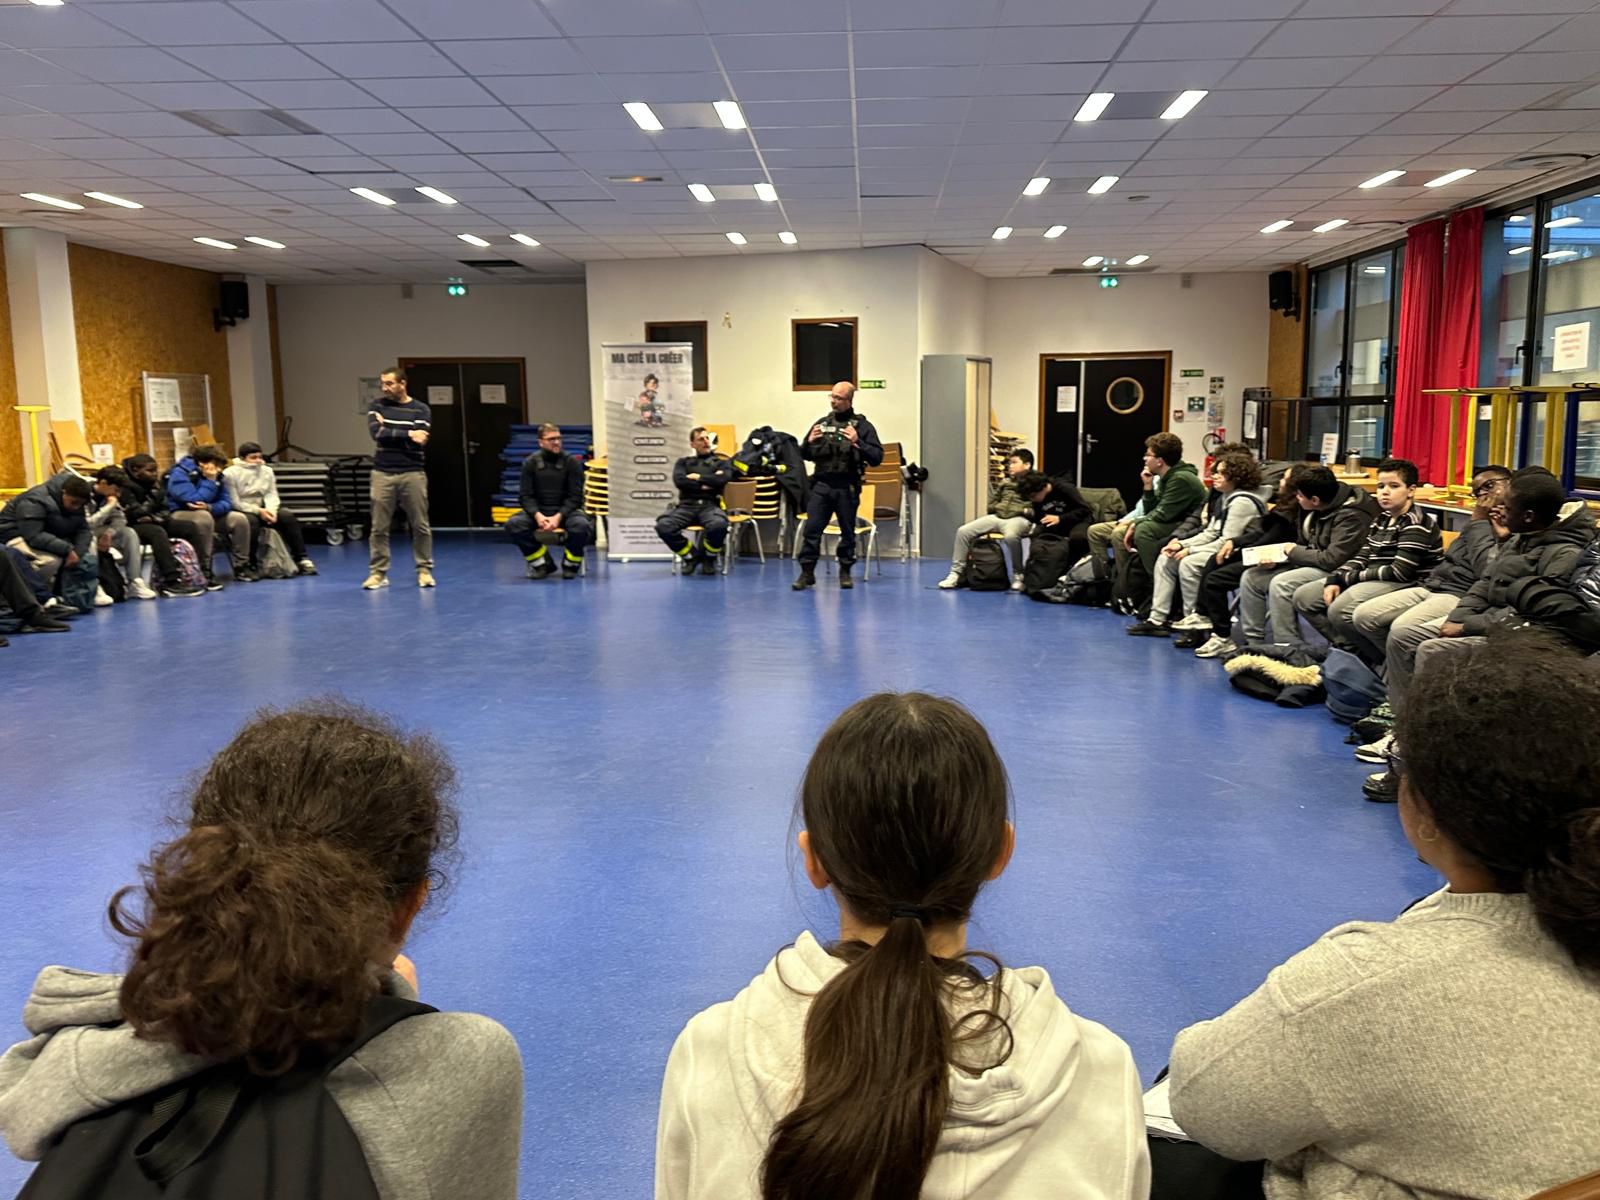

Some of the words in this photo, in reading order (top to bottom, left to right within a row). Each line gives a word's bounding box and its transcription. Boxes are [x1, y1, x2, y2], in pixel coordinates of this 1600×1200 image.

[611, 353, 625, 363] MA
[627, 351, 644, 363] CITÉ
[645, 353, 657, 363] VA
